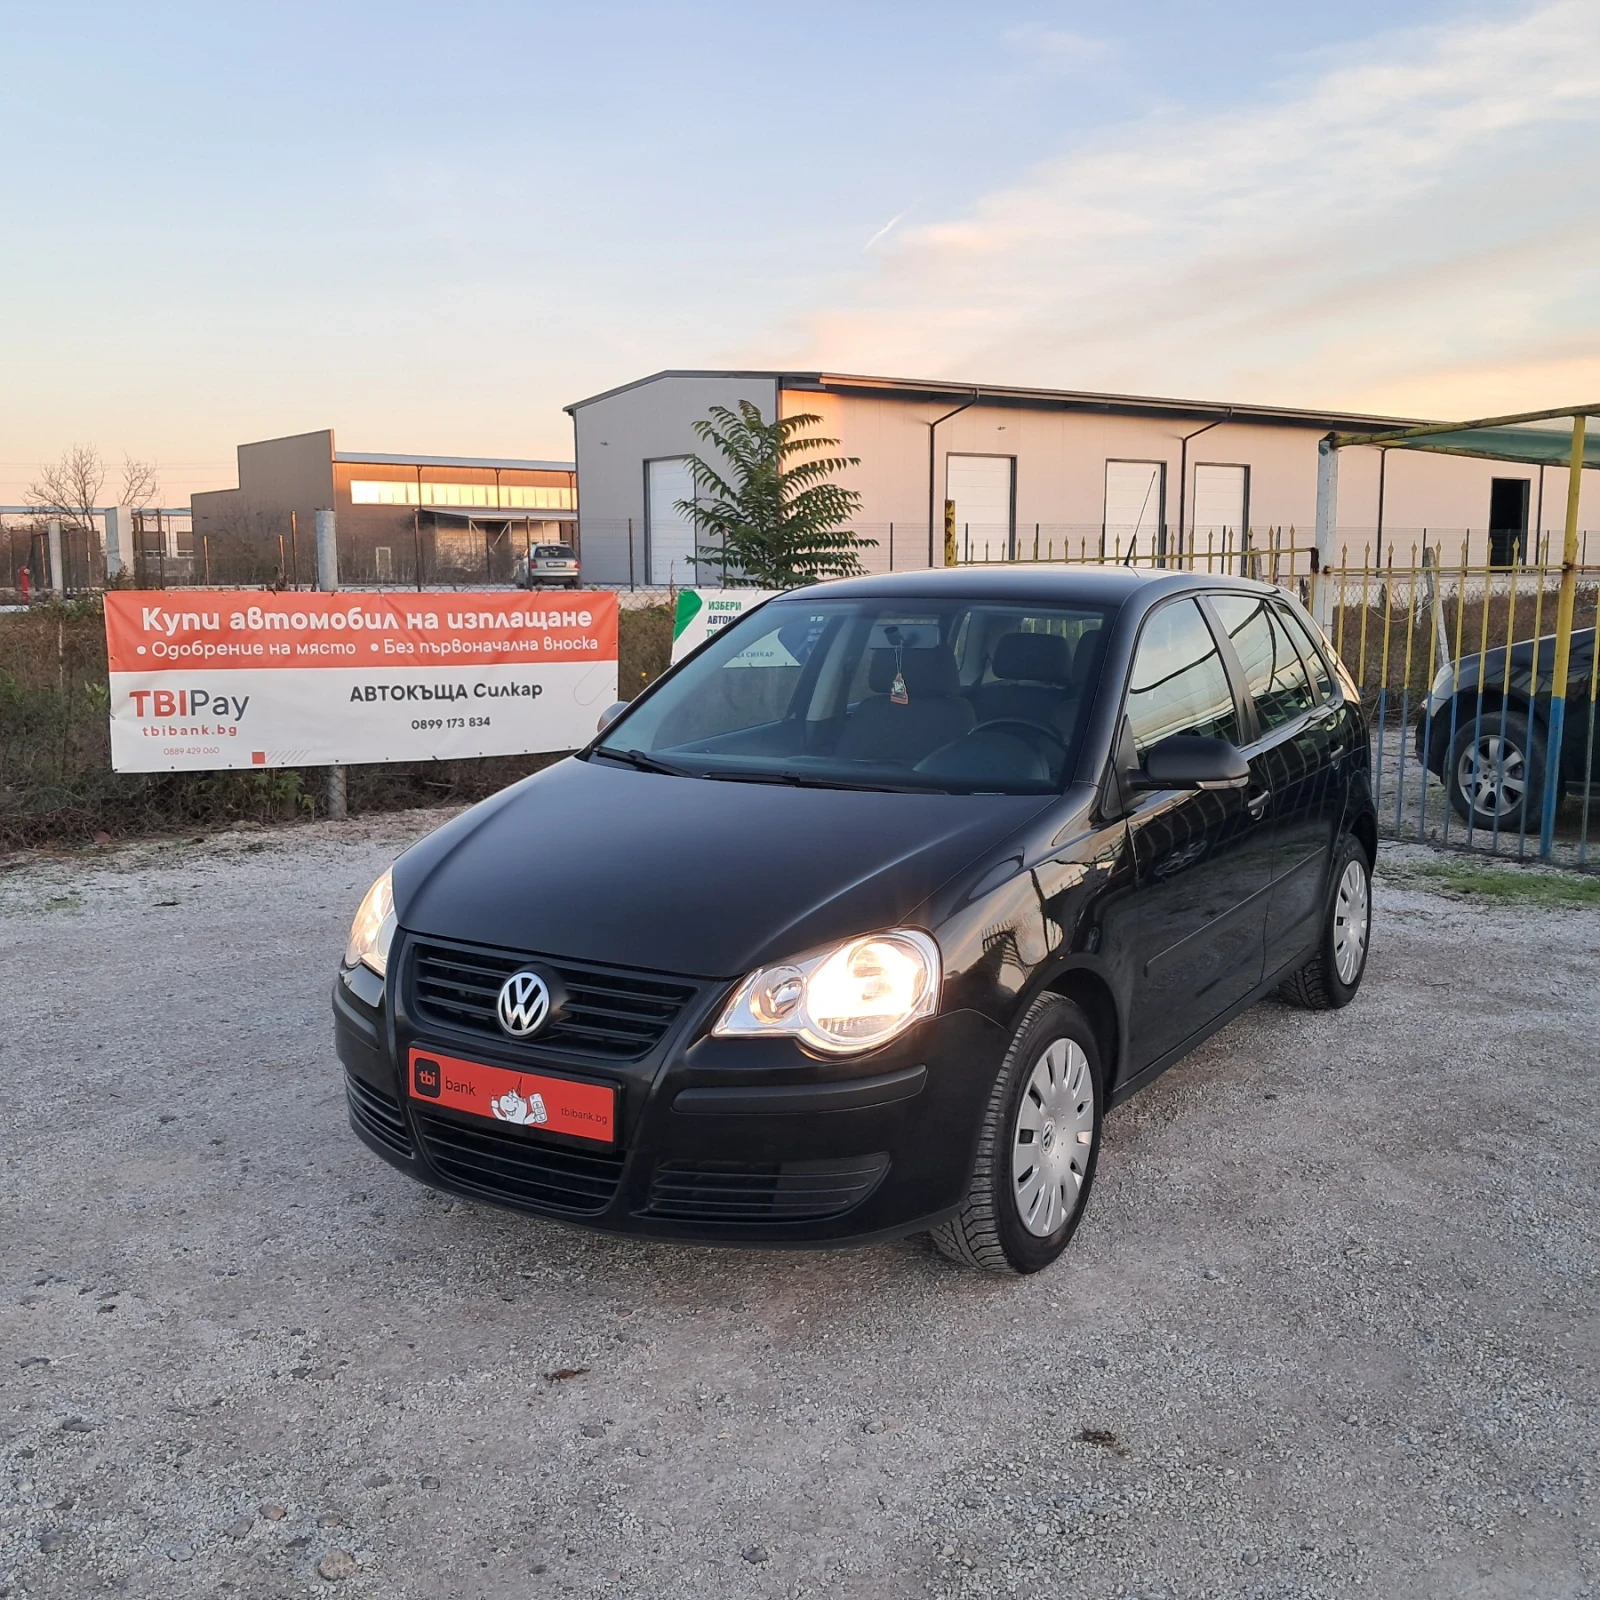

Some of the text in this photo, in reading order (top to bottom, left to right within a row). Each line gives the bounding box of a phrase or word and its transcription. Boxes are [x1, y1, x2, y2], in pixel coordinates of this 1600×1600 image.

[708, 601, 742, 611] ИЗБЕРИ
[141, 606, 593, 636] Купи автомобил на изплащане
[707, 615, 739, 625] АВТОМ
[151, 635, 598, 660] Одобрение на място Без първоначална вноска
[349, 682, 543, 702] АВТОКЪЩА Силкар
[129, 689, 250, 721] TBIPay
[142, 724, 237, 737] tbibank.bg
[411, 716, 491, 730] 0899 173 834
[163, 746, 220, 756] 0889 429 060
[418, 1070, 476, 1097] tbi bank
[560, 1106, 608, 1126] tbibank.bg
